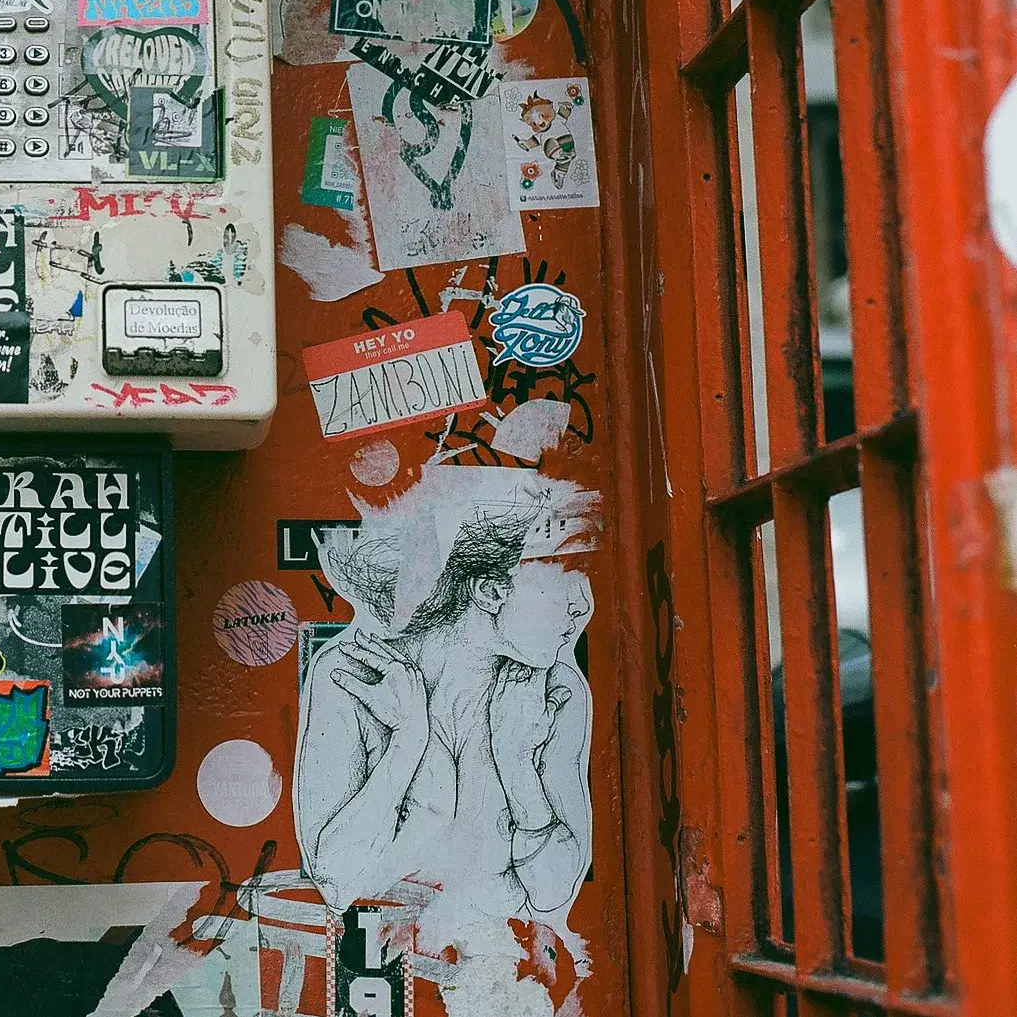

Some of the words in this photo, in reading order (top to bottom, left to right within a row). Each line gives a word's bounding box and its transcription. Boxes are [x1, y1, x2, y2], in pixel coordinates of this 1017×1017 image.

[128, 304, 197, 320] Devolução
[128, 320, 145, 334] de
[147, 321, 198, 335] Moedas
[353, 334, 388, 355] HEY
[391, 327, 417, 346] YO
[364, 349, 383, 361] they
[382, 345, 396, 356] call
[397, 342, 410, 352] me
[68, 687, 91, 699] NOT
[92, 687, 120, 698] YOUR
[121, 686, 163, 699] PUPPETS
